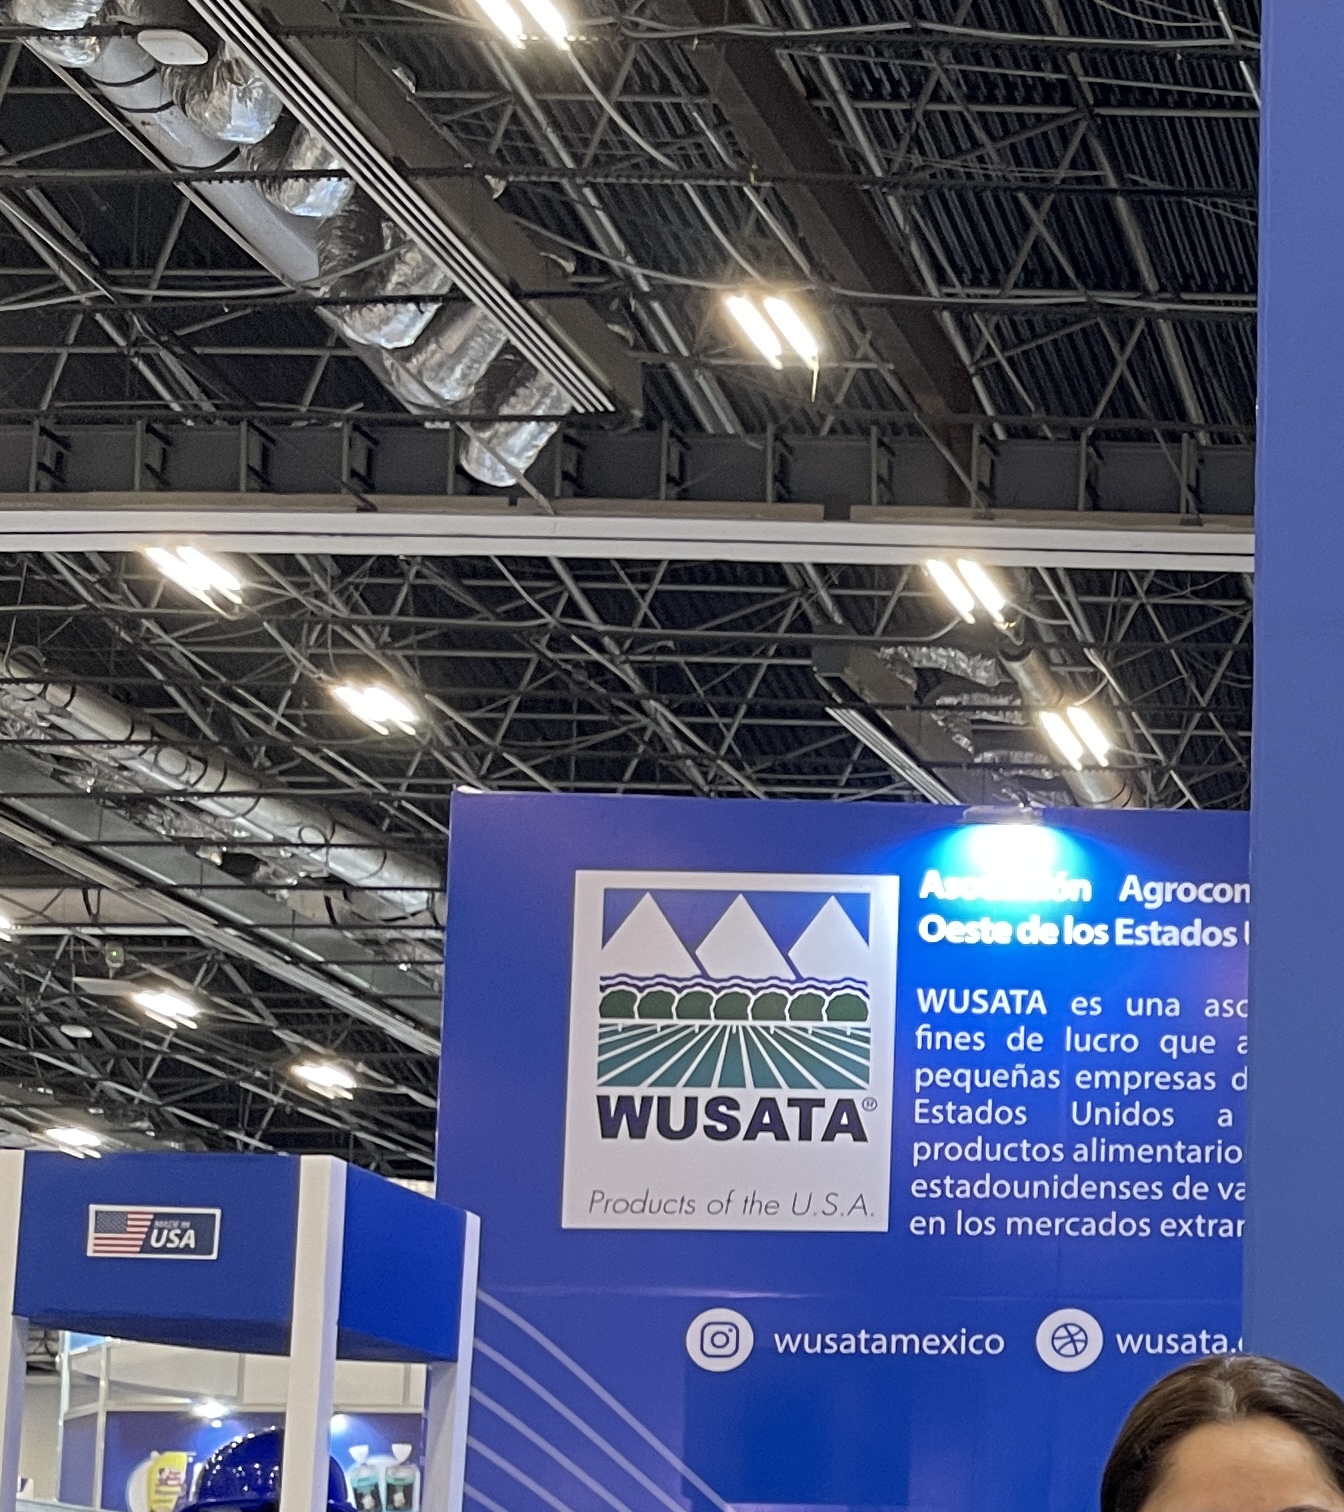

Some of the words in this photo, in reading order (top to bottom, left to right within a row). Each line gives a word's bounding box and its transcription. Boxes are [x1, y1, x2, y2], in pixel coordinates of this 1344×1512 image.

[918, 914, 1012, 944] Oeste
[1017, 915, 1059, 945] de
[1064, 915, 1109, 945] los
[1115, 918, 1237, 946] Estados
[917, 988, 1047, 1015] WUSATA
[1071, 996, 1102, 1016] es
[1126, 997, 1180, 1017] una
[916, 1024, 985, 1051] fines
[1007, 1026, 1043, 1052] de
[1066, 1026, 1139, 1053] lucro
[1160, 1033, 1216, 1059] que
[915, 1063, 1060, 1093] pequeñas
[1075, 1070, 1216, 1095] empresas
[914, 1099, 1027, 1125] Estados
[1071, 1101, 1174, 1127] Unidos
[1217, 1108, 1234, 1127] a
[913, 1136, 1064, 1166] productos
[911, 1173, 1164, 1200] estadounidenses
[1172, 1175, 1209, 1200] de
[588, 1188, 696, 1216] Products
[707, 1189, 736, 1216] of
[742, 1190, 780, 1216] the
[791, 1191, 875, 1218] U.S.A.
[909, 1214, 945, 1236] en
[956, 1209, 997, 1236] los
[1006, 1210, 1151, 1238] mercados
[150, 1229, 196, 1249] USA
[774, 1327, 1005, 1355] wusatamexico
